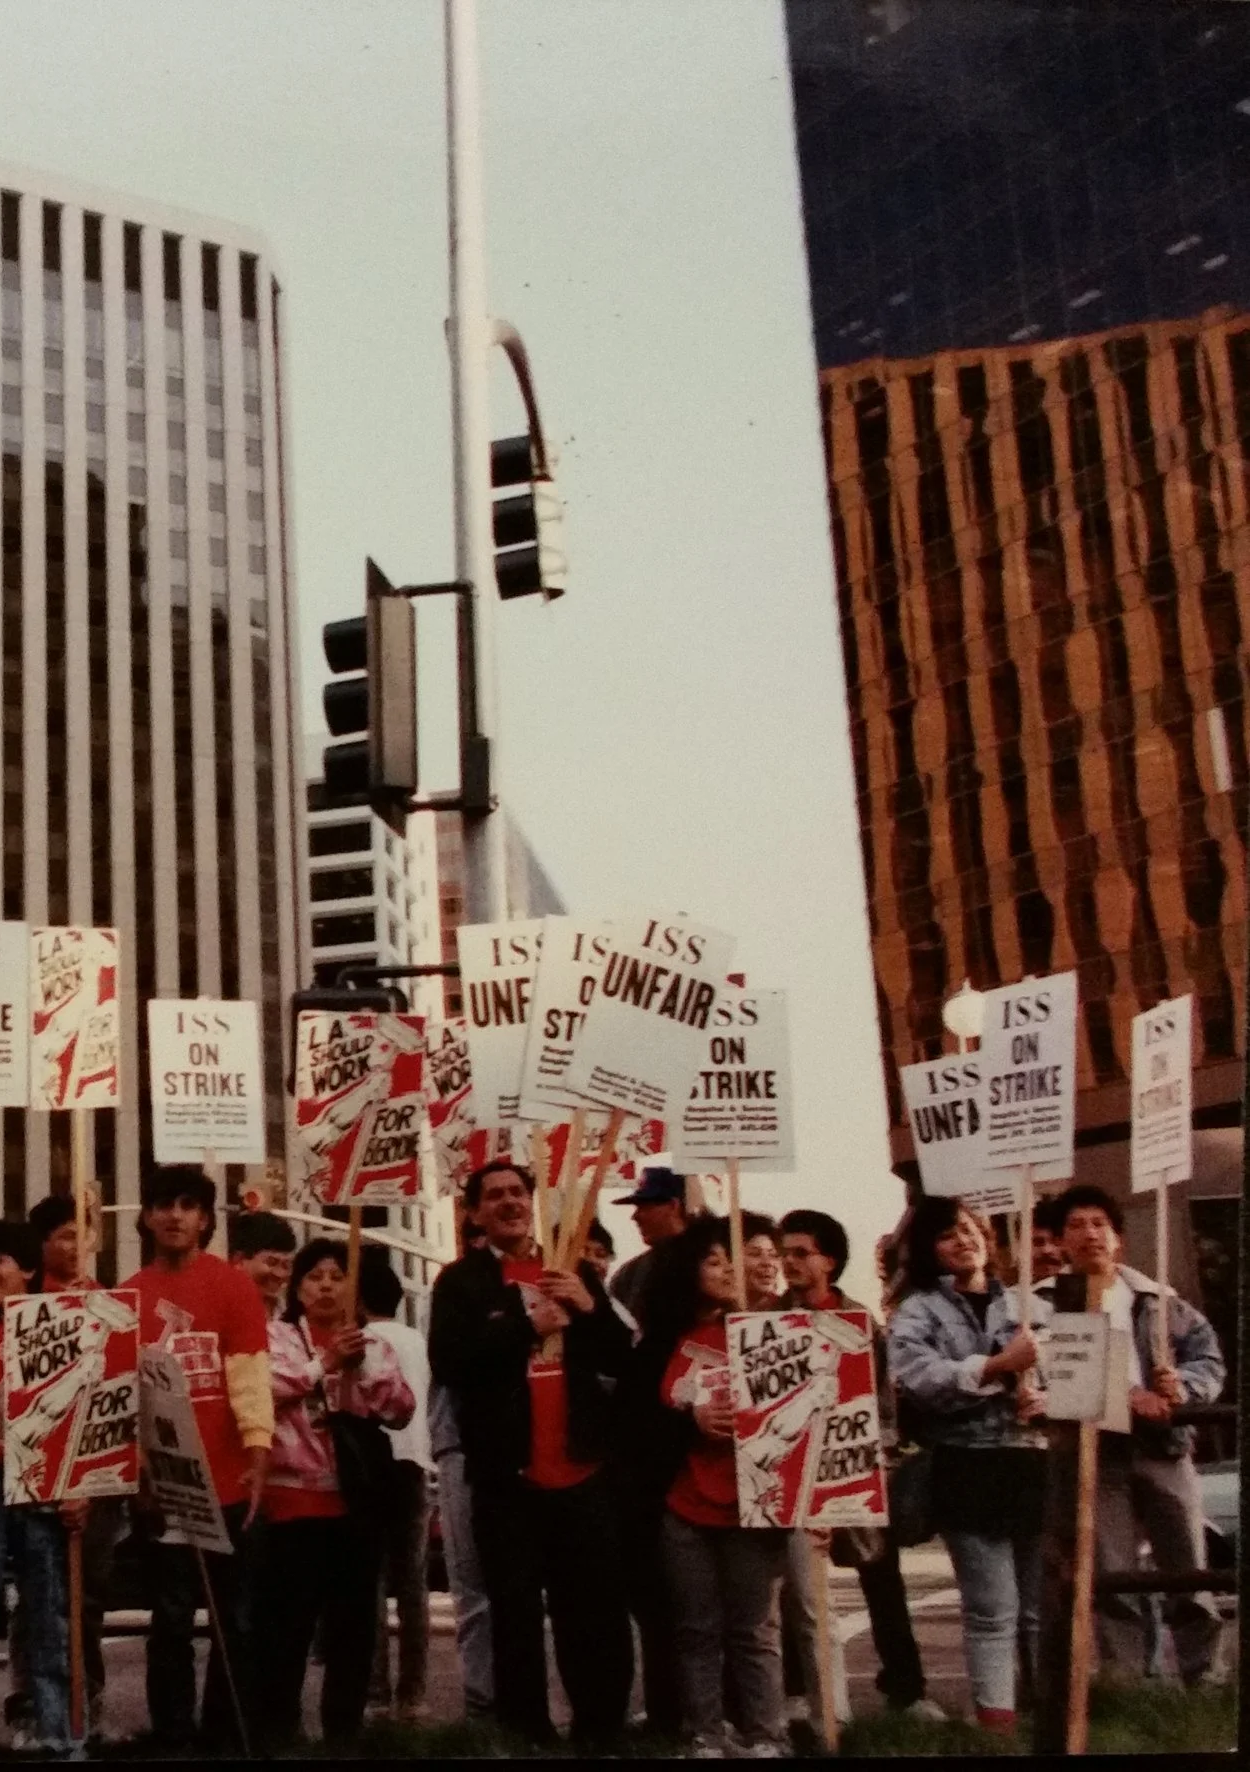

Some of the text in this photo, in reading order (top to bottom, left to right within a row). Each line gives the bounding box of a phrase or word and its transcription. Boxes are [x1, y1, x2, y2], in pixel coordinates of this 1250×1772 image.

[642, 920, 707, 965] ISS
[41, 968, 83, 1005] WORK
[602, 952, 716, 1030] UNFAIR
[177, 1012, 230, 1034] ISS
[712, 999, 759, 1026] SS
[1002, 992, 1052, 1029] ISS
[189, 1043, 219, 1066] ON
[310, 1035, 374, 1067] SHOULD
[709, 1036, 745, 1065] ON
[1012, 1032, 1040, 1065] ON
[164, 1071, 247, 1097] STRIKE
[311, 1054, 371, 1096] WORK
[925, 1063, 982, 1095] ISS
[989, 1065, 1062, 1106] STRIKE
[372, 1105, 416, 1135] FOR
[17, 1315, 85, 1356] SHOULD
[19, 1336, 82, 1386] WORK
[743, 1335, 812, 1374] SHOULD
[746, 1355, 813, 1404] WORK
[87, 1385, 132, 1421] FOR
[823, 1410, 870, 1446] FOR
